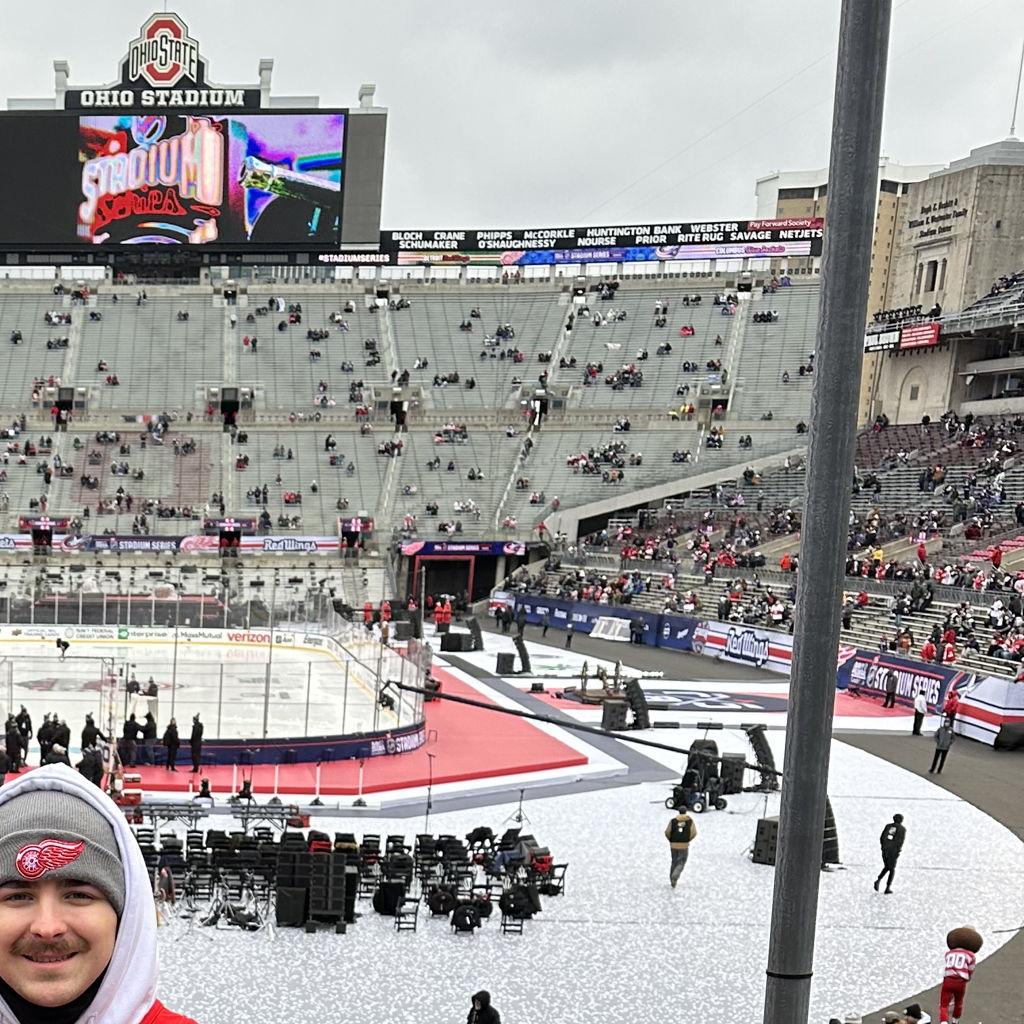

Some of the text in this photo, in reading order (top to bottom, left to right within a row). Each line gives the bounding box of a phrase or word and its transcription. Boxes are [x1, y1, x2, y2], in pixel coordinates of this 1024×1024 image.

[131, 35, 196, 78] OHIO STATE
[80, 90, 245, 106] OHIO STADIUM
[81, 126, 224, 223] STADIUM
[788, 219, 812, 227] Society
[392, 229, 575, 241] BLOCH CRANE PHIPPS McCORKLE
[587, 223, 739, 237] HUNTINGTON BANK WEBSTER
[577, 228, 823, 246] NOURSE PRIOR RITE RUG SAVAGE NETJETS
[399, 239, 556, 249] SCHUMAKER O'SHAUGHNESSY
[318, 254, 390, 263] #STADIUMSERIES
[119, 541, 150, 550] STADIUM
[151, 541, 176, 550] SERIES
[227, 631, 271, 643] verizon
